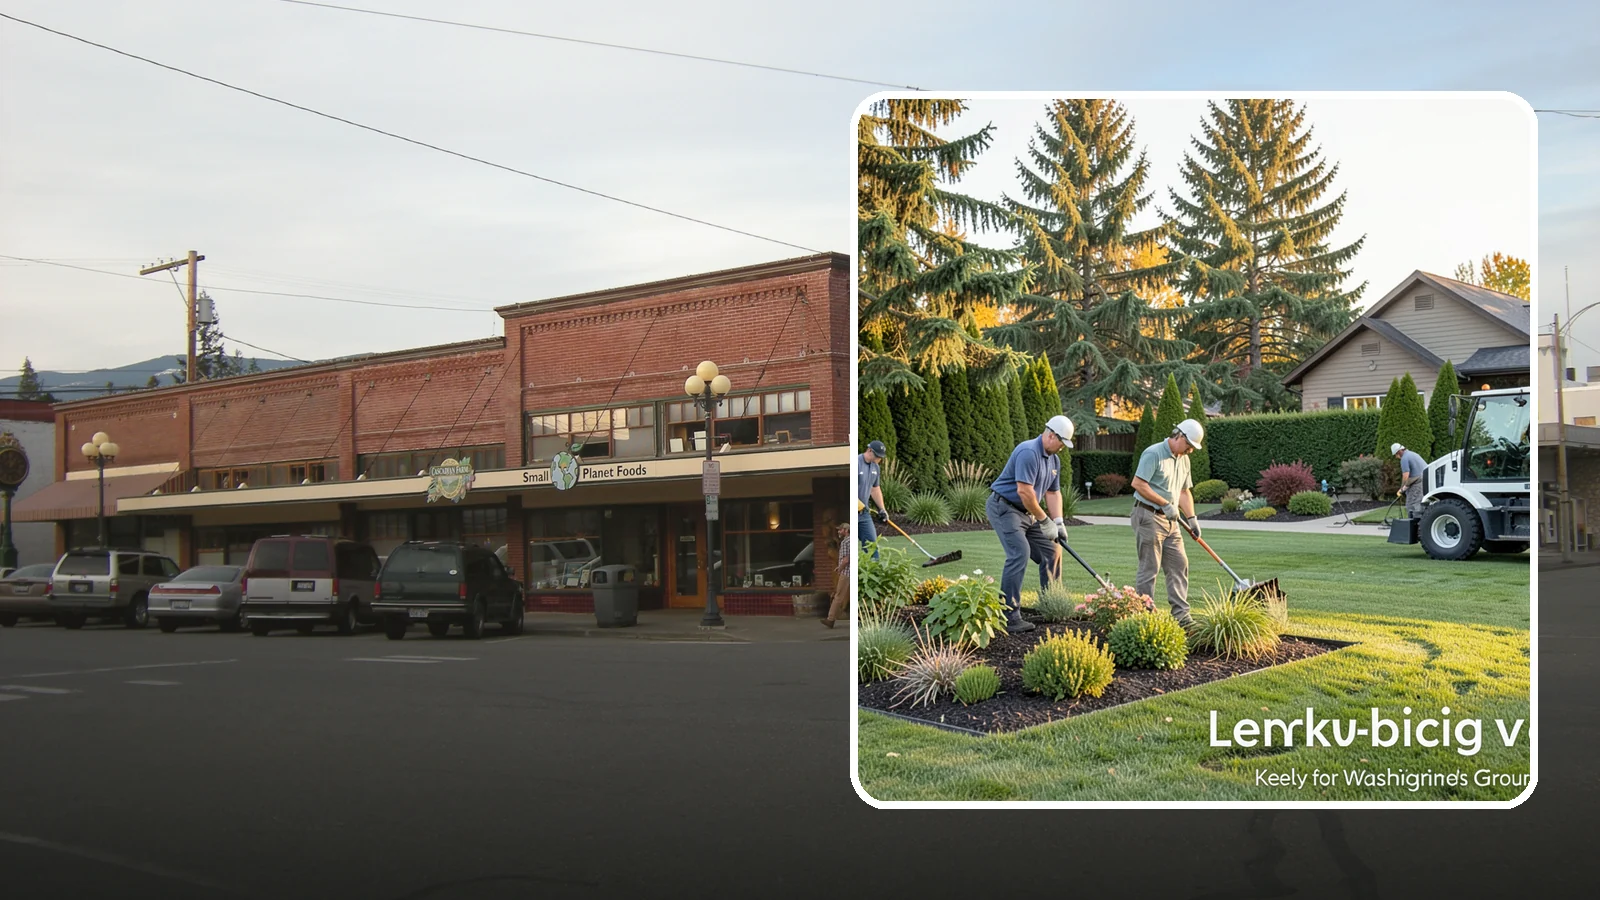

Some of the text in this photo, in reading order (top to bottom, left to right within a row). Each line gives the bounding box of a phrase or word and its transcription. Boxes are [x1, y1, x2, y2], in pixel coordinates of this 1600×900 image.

[523, 464, 647, 483] Small Planet Foods
